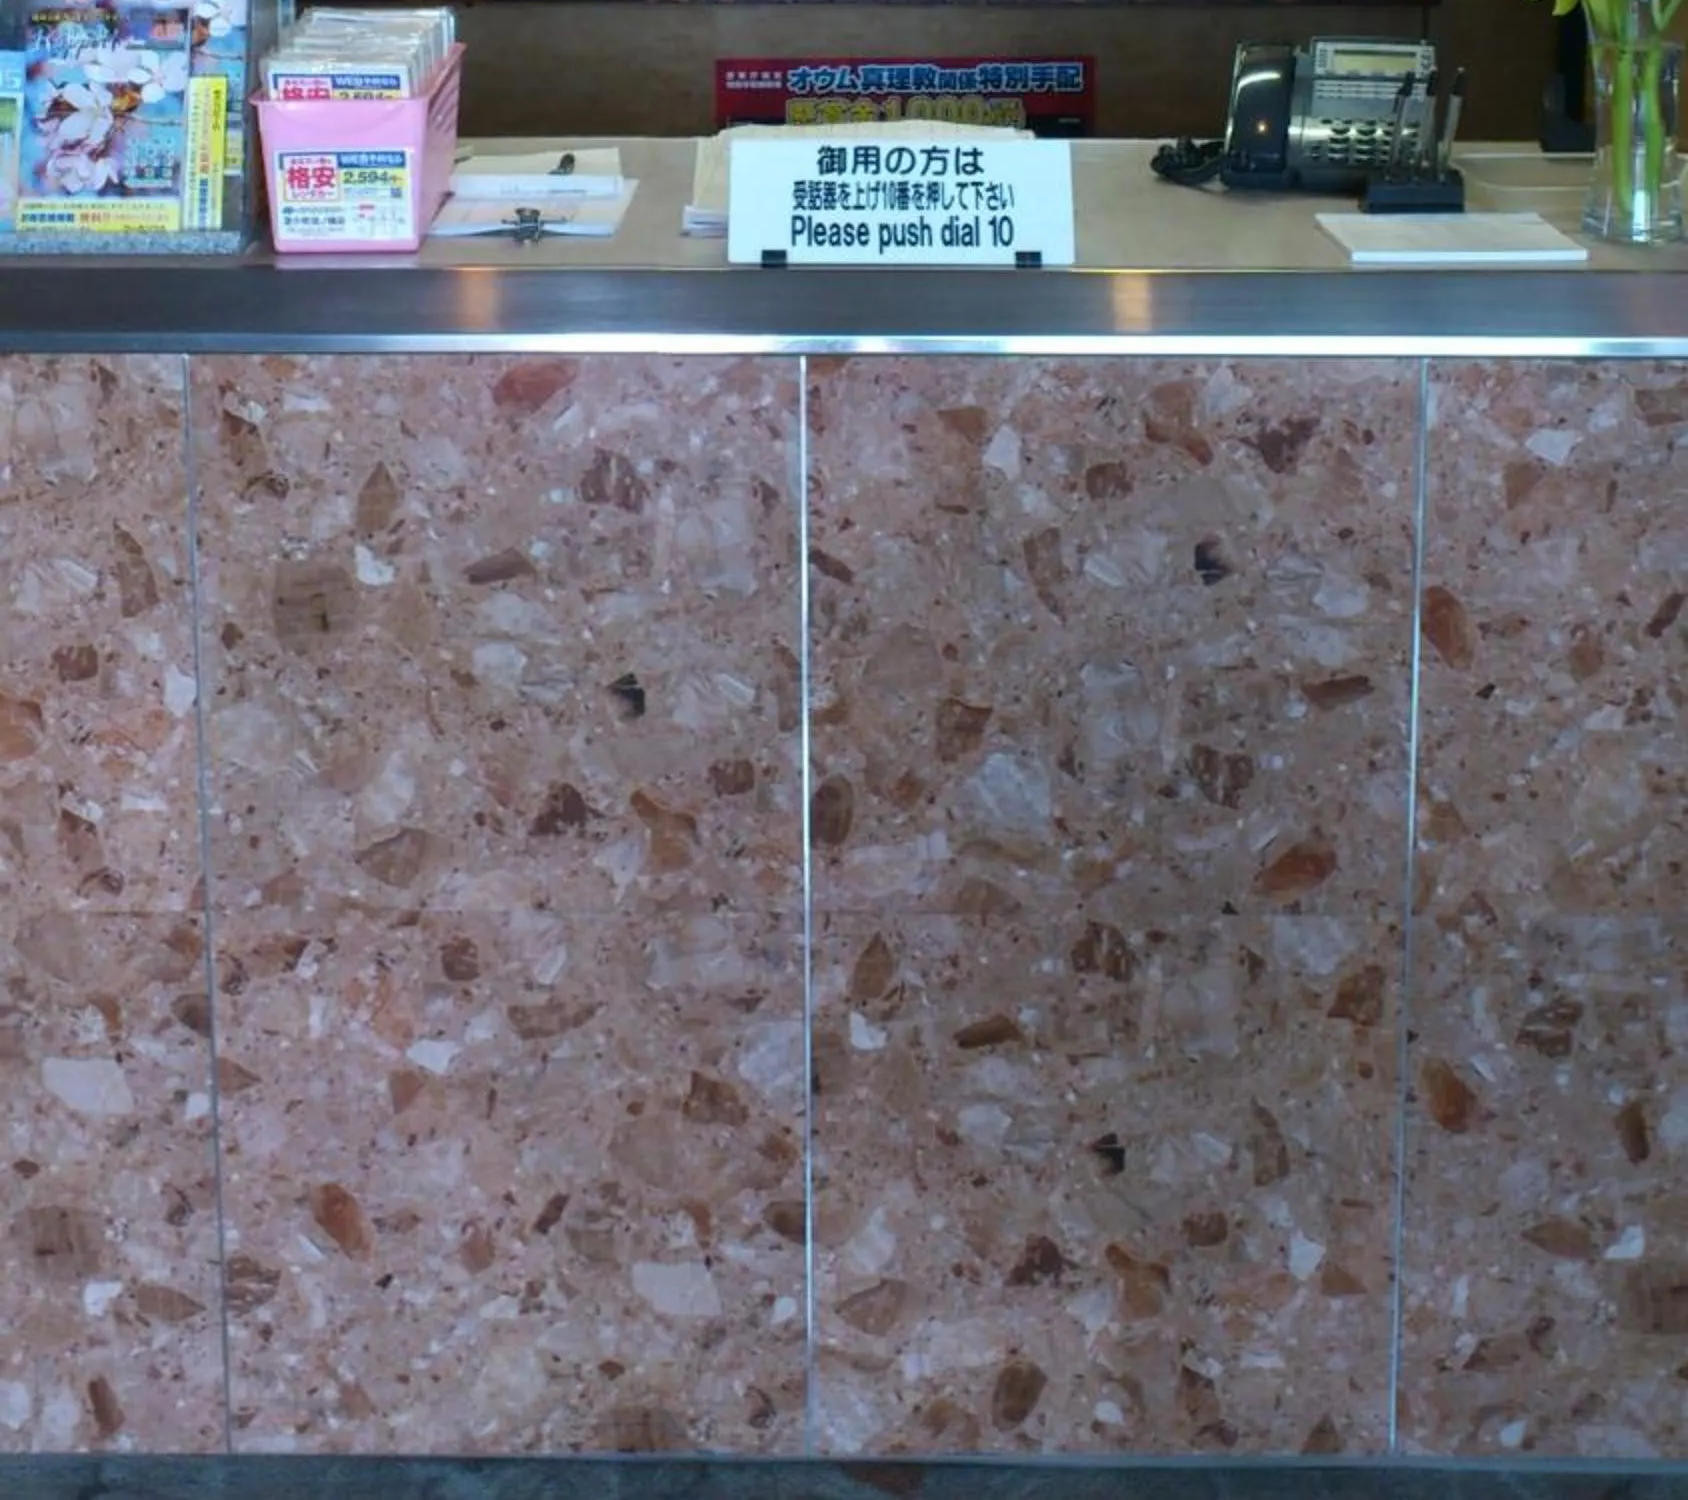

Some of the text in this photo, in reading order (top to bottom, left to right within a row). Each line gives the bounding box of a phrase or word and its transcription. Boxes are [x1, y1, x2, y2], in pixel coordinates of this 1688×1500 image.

[817, 145, 985, 176] 御用の方は
[287, 166, 336, 188] 格安
[792, 180, 1015, 211] 受話器を上げ10番を押して下さい
[791, 215, 1015, 255] Please push dial 10
